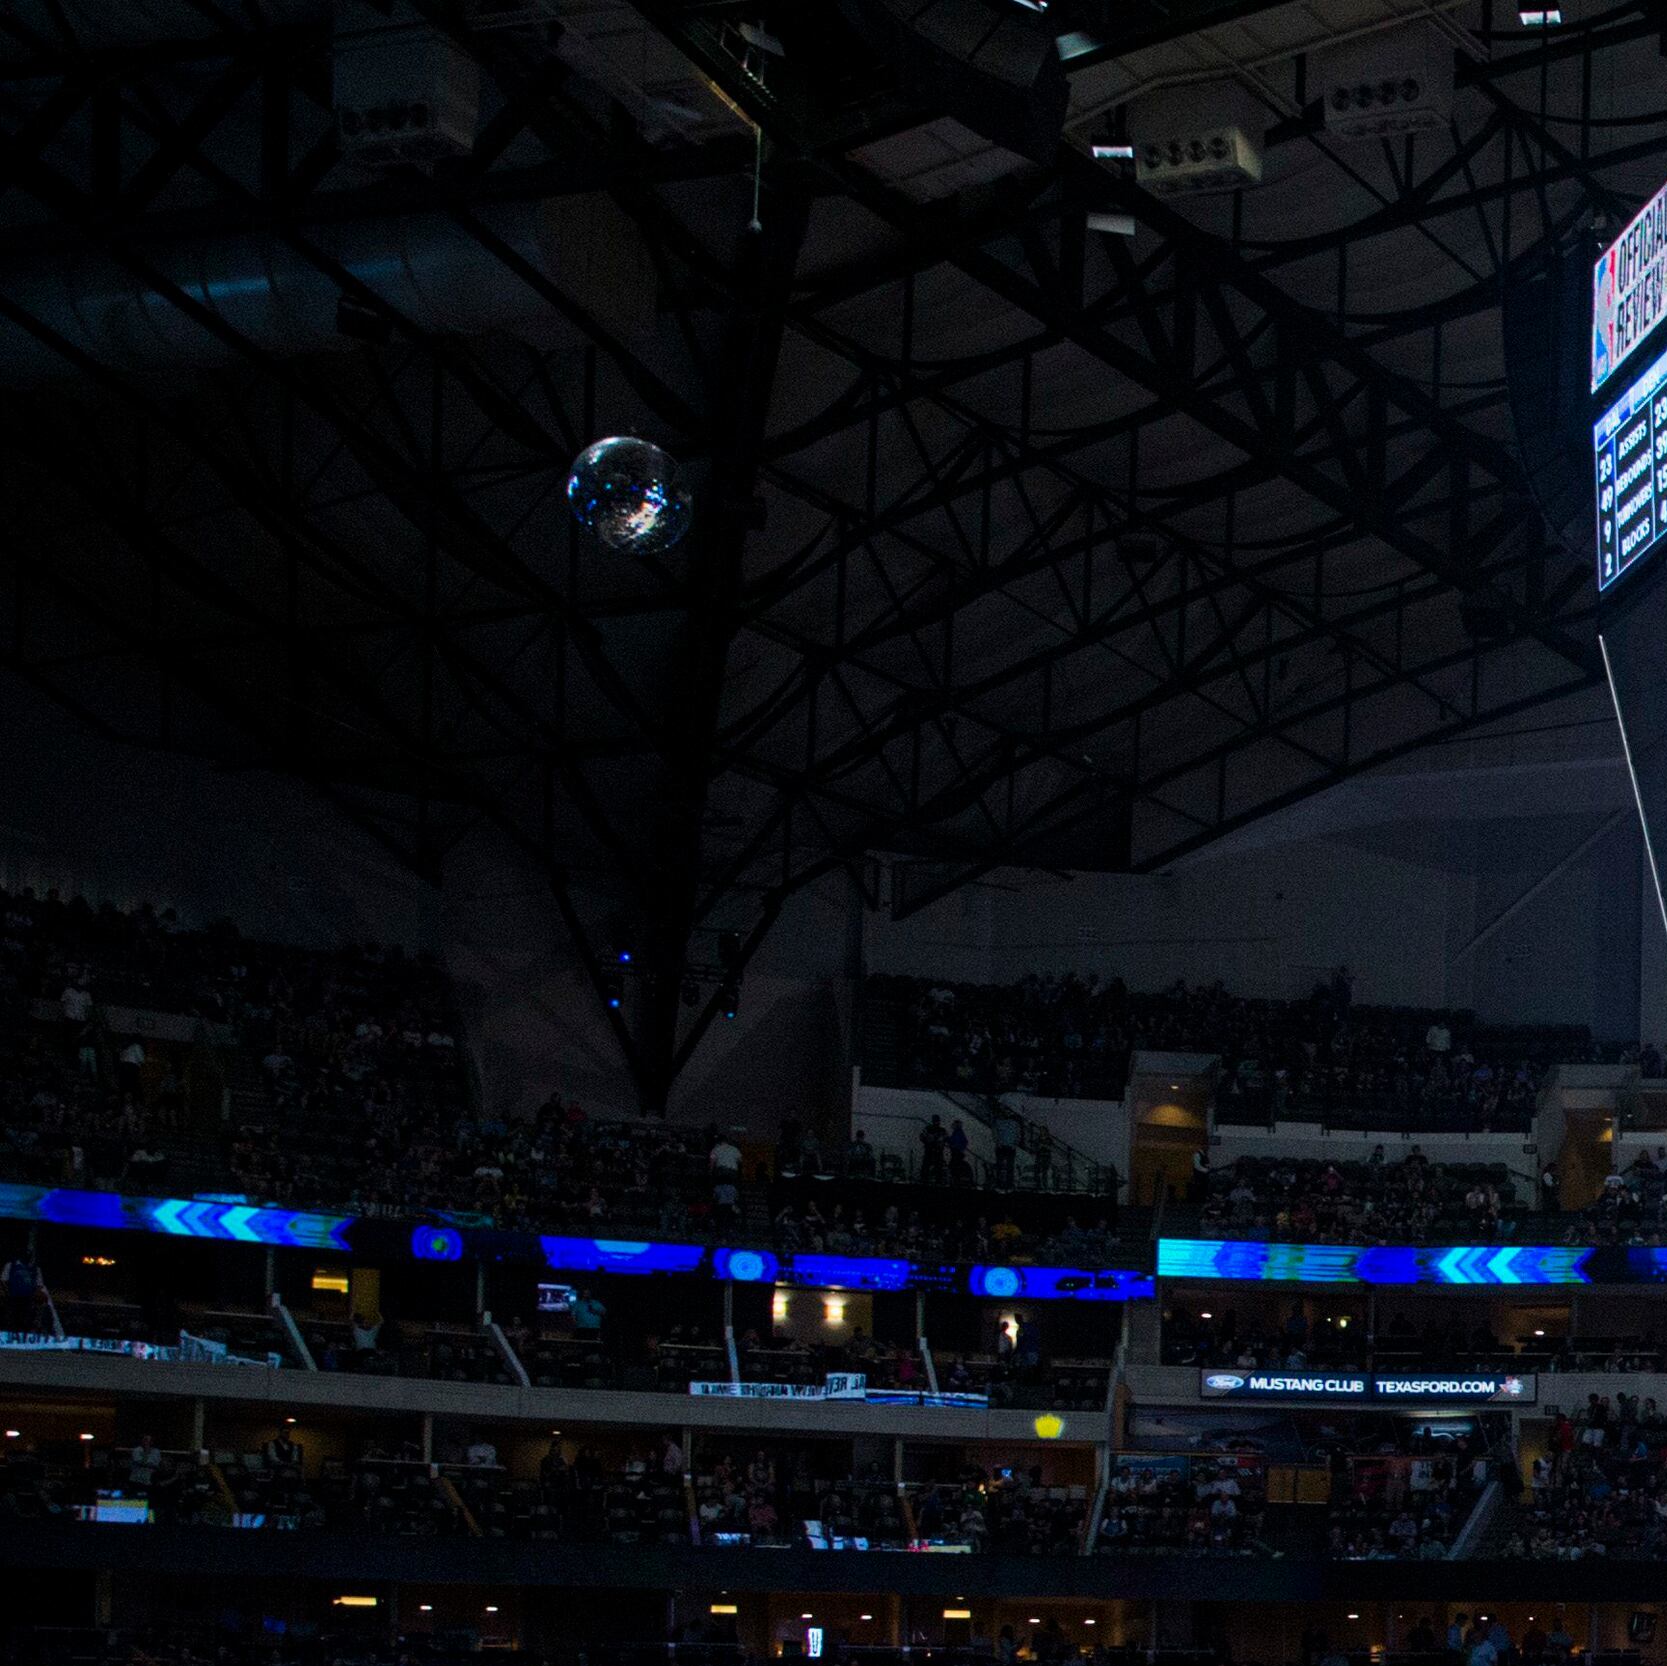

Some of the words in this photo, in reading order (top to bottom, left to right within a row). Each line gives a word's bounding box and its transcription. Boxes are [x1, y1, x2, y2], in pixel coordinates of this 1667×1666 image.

[1616, 255, 1665, 358] REVIEW
[1654, 396, 1667, 428] 23
[1250, 1376, 1323, 1392] MUSTANG
[1325, 1378, 1364, 1392] CLUB
[1375, 1379, 1495, 1394] TEXASFORD.COM
